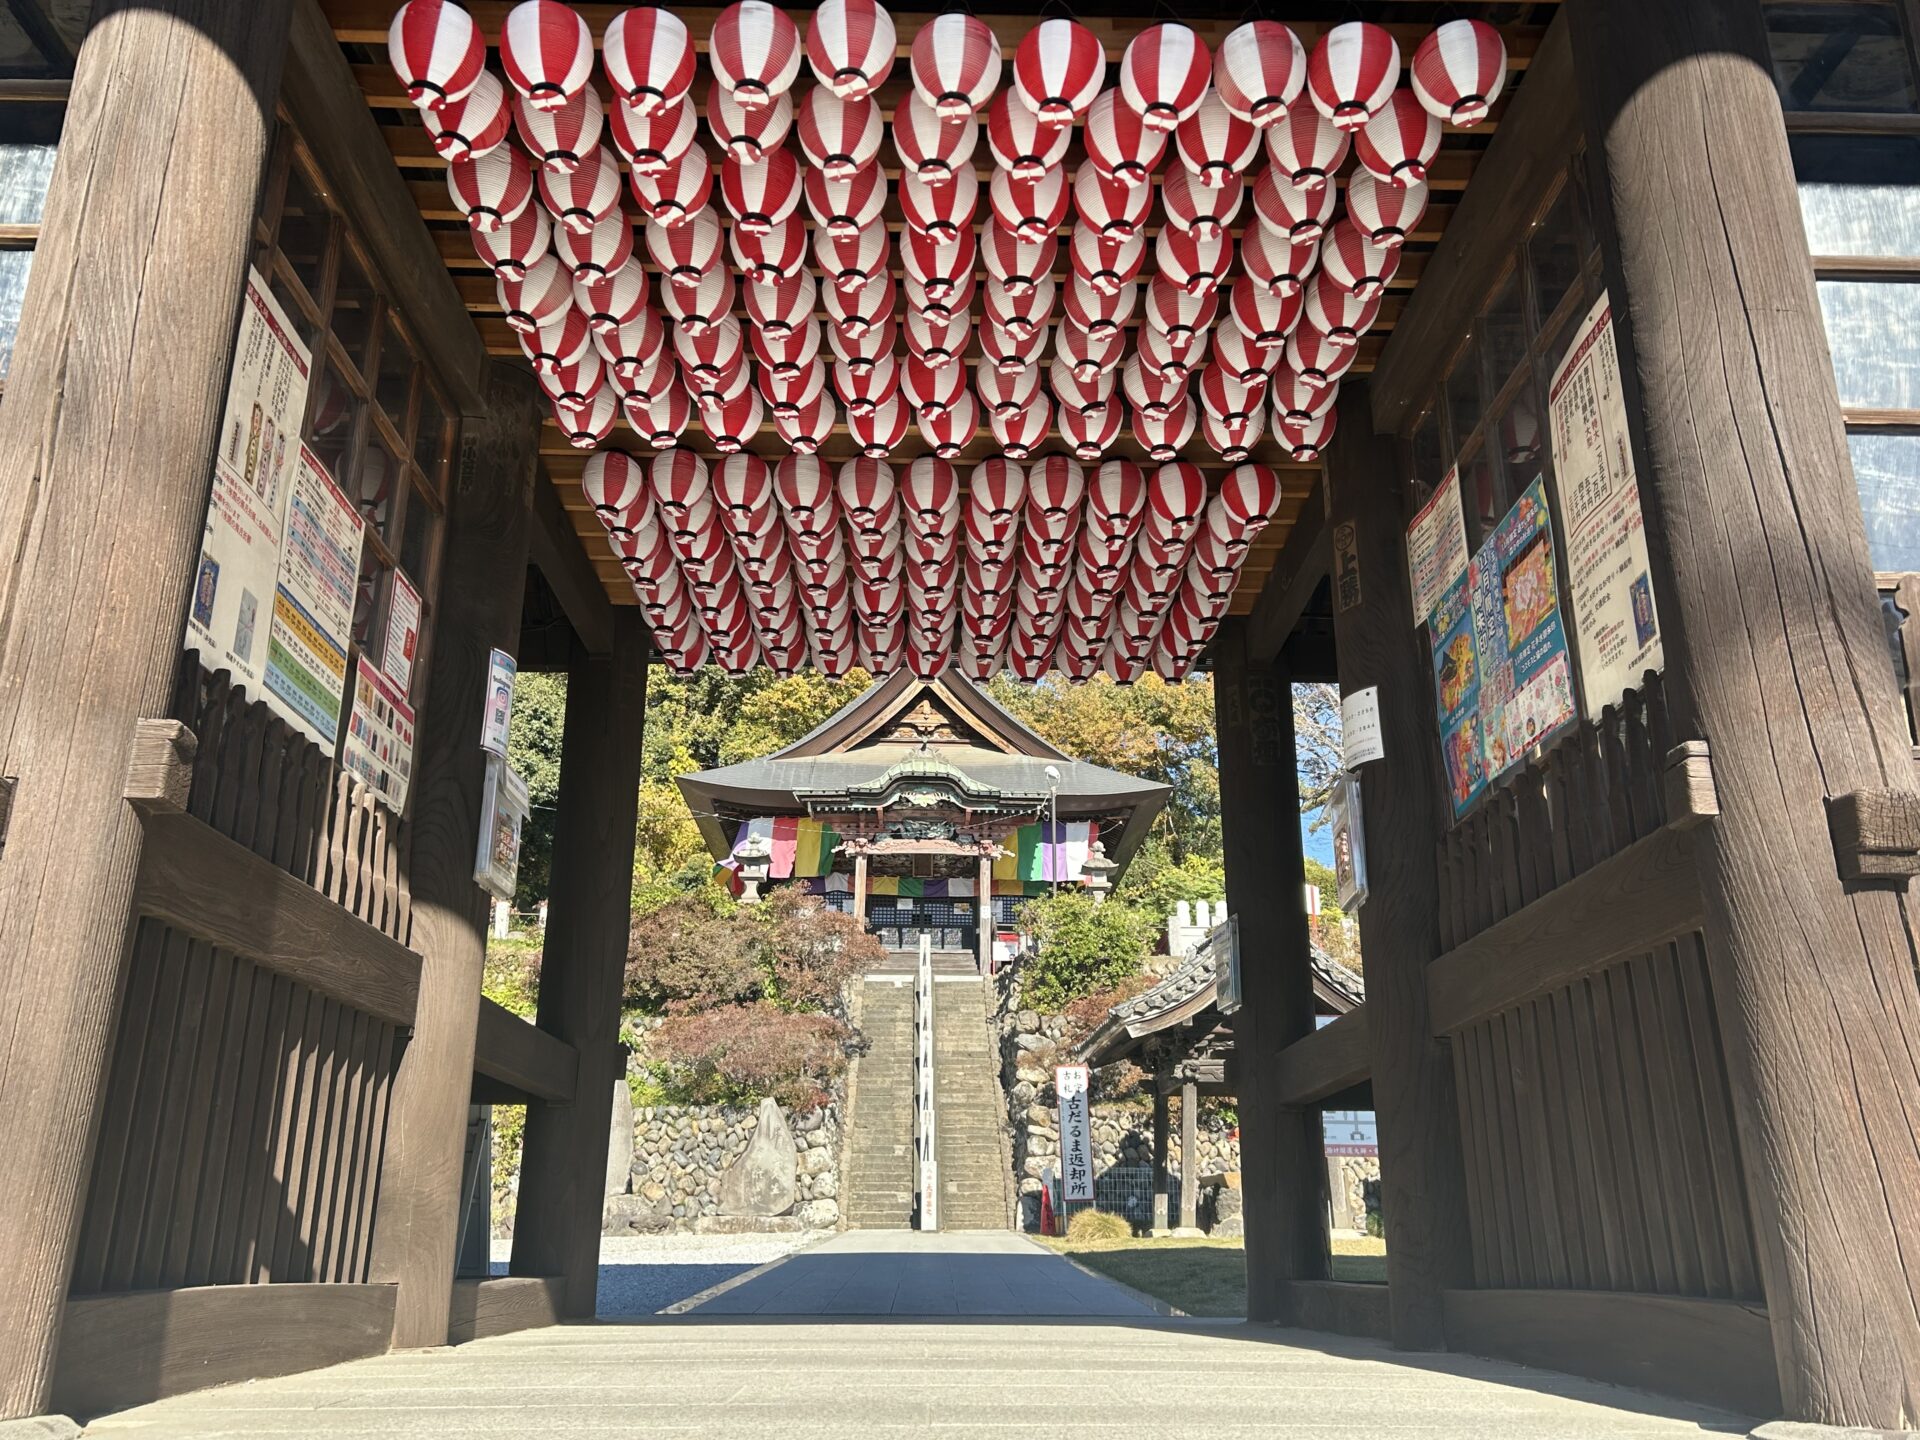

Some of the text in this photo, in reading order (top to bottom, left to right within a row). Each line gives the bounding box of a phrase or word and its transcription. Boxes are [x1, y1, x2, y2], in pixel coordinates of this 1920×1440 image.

[1067, 1096, 1088, 1197] 古だるま返却所
